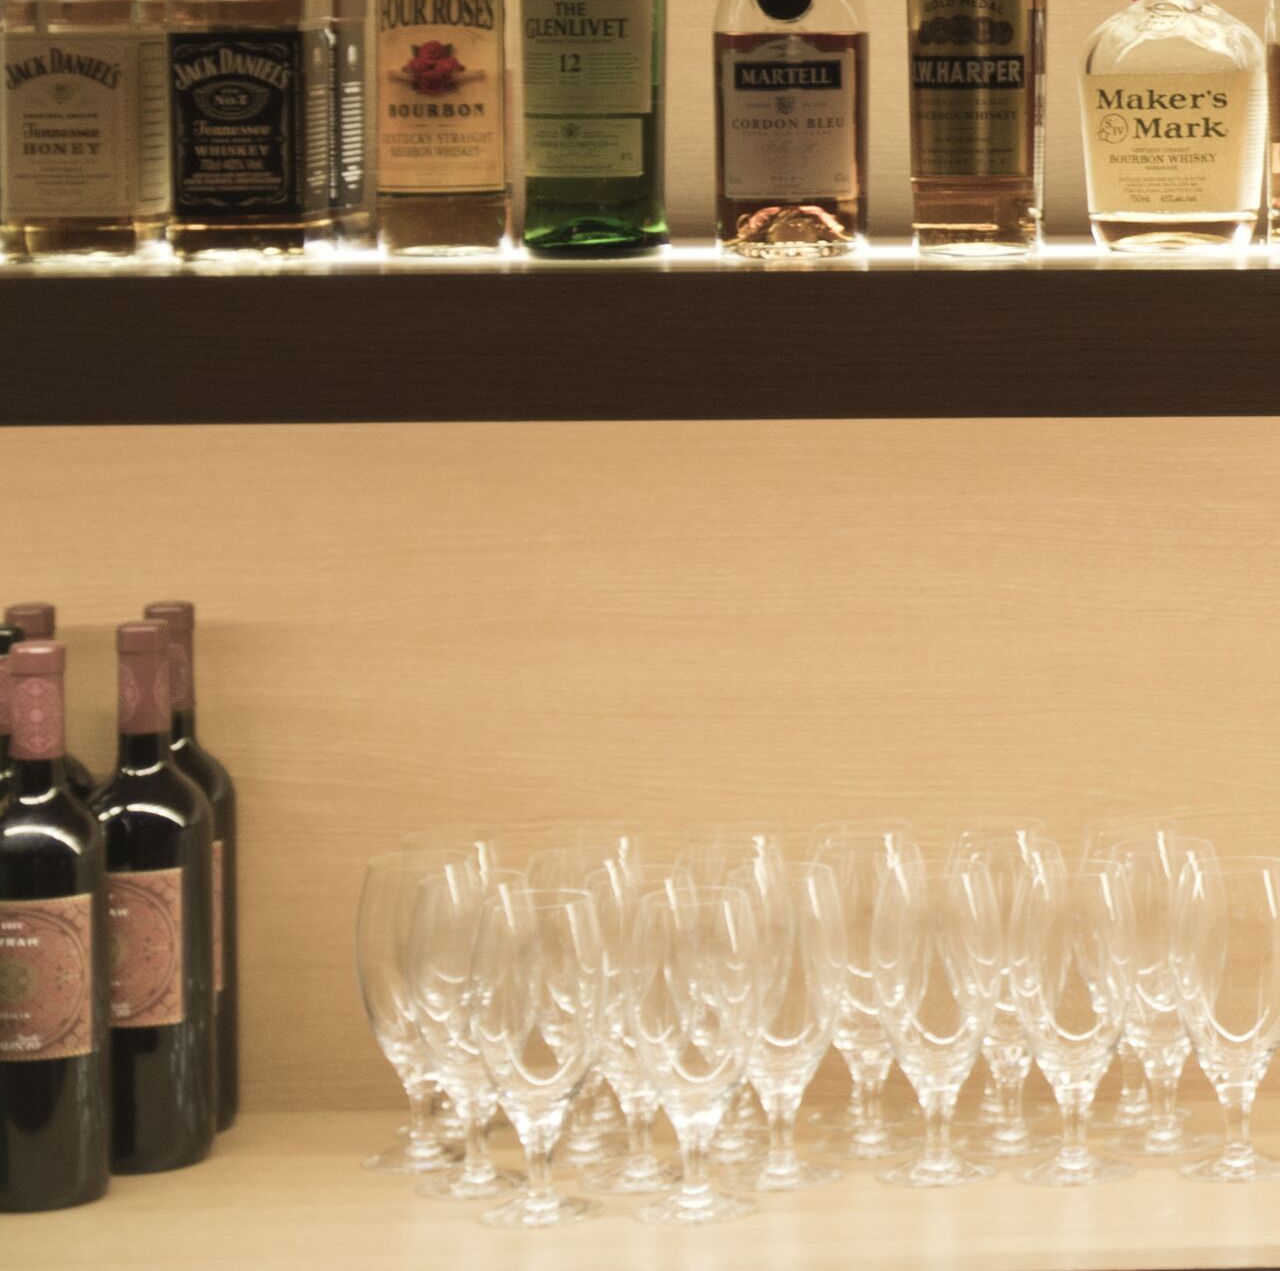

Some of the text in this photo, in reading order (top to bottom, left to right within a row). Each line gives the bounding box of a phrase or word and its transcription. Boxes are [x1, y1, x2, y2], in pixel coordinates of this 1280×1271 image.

[555, 1, 588, 17] THE
[526, 18, 628, 40] GLENLIVET
[558, 53, 582, 74] 12
[5, 55, 49, 90] JACK
[174, 55, 218, 91] JACK
[742, 68, 832, 85] MARTELL
[1096, 88, 1229, 110] Maker's
[389, 103, 484, 117] BOURBON
[732, 117, 844, 130] CORDON BLEU
[1133, 117, 1227, 139] Mark
[23, 142, 102, 155] HONEY
[195, 145, 270, 156] WHISKEY
[1108, 153, 1217, 165] BOURBON WHISKY
[0, 937, 40, 947] YRAH
